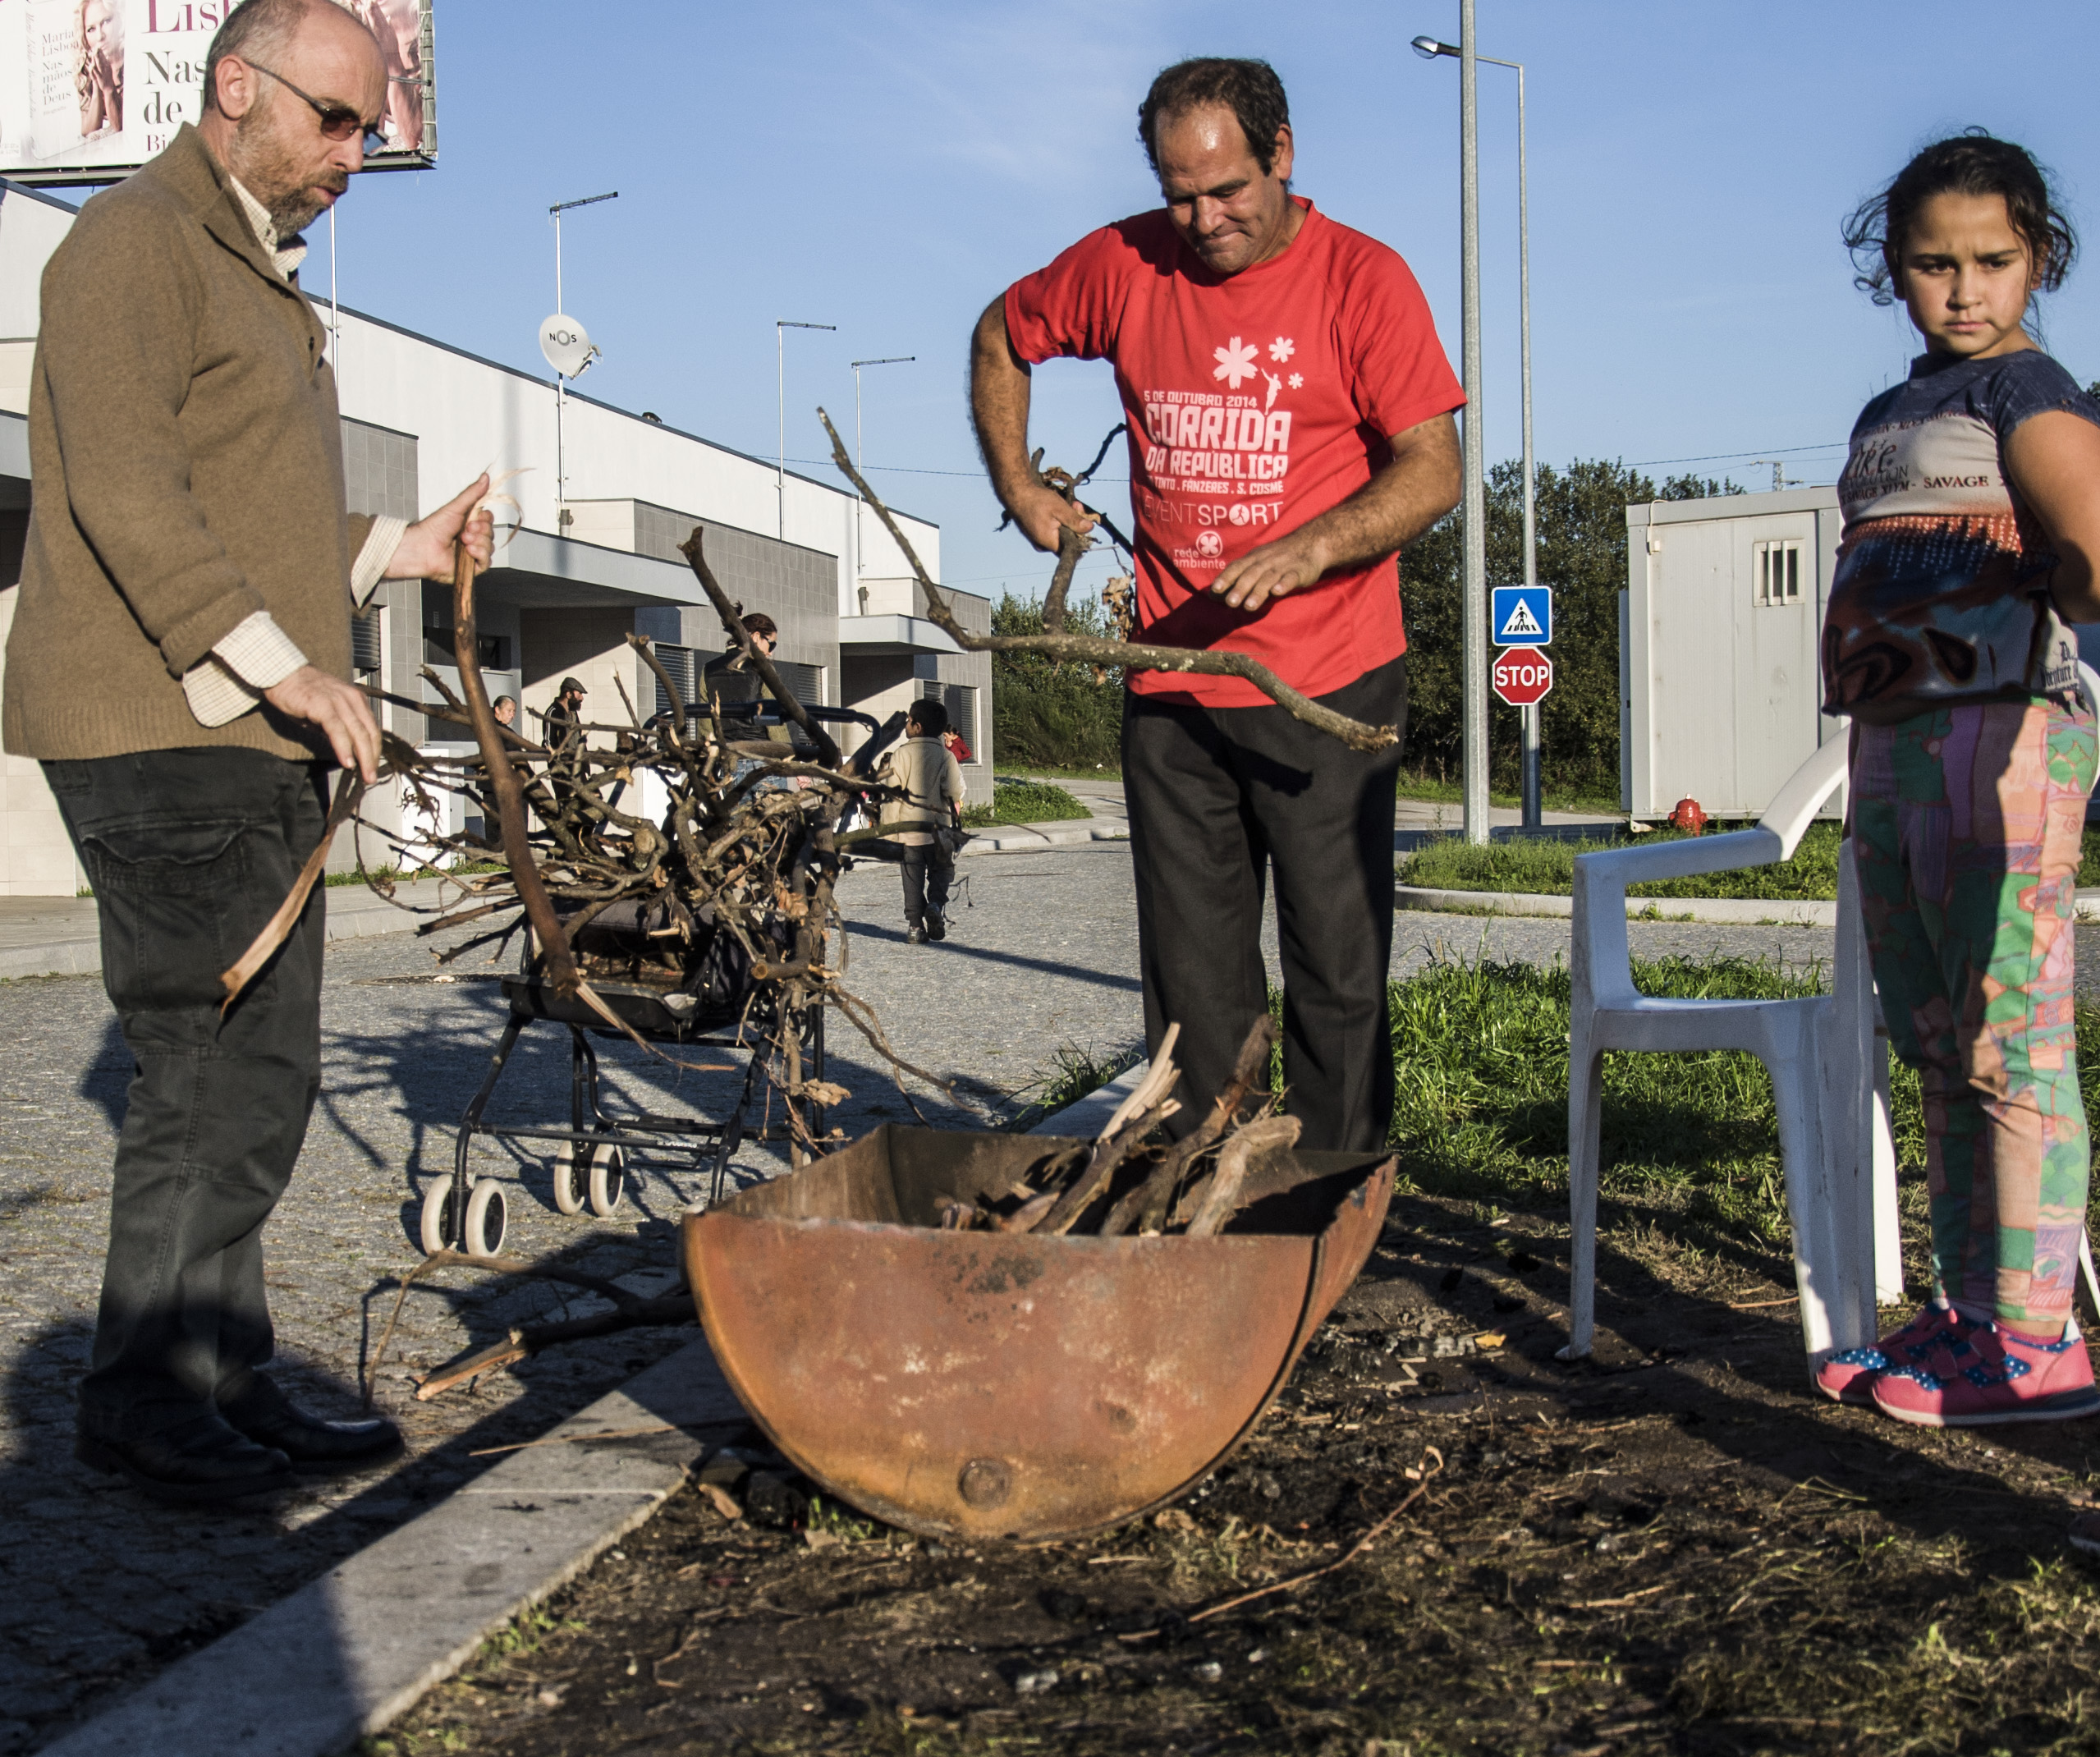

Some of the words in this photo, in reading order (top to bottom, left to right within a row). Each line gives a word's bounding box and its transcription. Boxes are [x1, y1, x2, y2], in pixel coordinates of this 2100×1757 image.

[42, 30, 74, 45] Maria
[42, 40, 80, 57] Lisboa
[43, 61, 63, 71] Nas
[43, 84, 56, 94] de
[43, 93, 71, 106] Deus
[144, 91, 182, 125] de
[549, 330, 577, 346] NOS
[1144, 390, 1150, 402] 5
[1153, 391, 1165, 403] DE
[1167, 392, 1222, 406] OUTUBRO
[1226, 396, 1258, 408] 2014
[1145, 402, 1292, 452] CORRIDA
[1145, 446, 1167, 474] DA
[1249, 480, 1284, 495] COSME
[1923, 475, 1989, 489] SAVAGE
[1174, 548, 1199, 558] rede
[1174, 558, 1227, 570] ambiente
[1496, 665, 1549, 686] STOP
